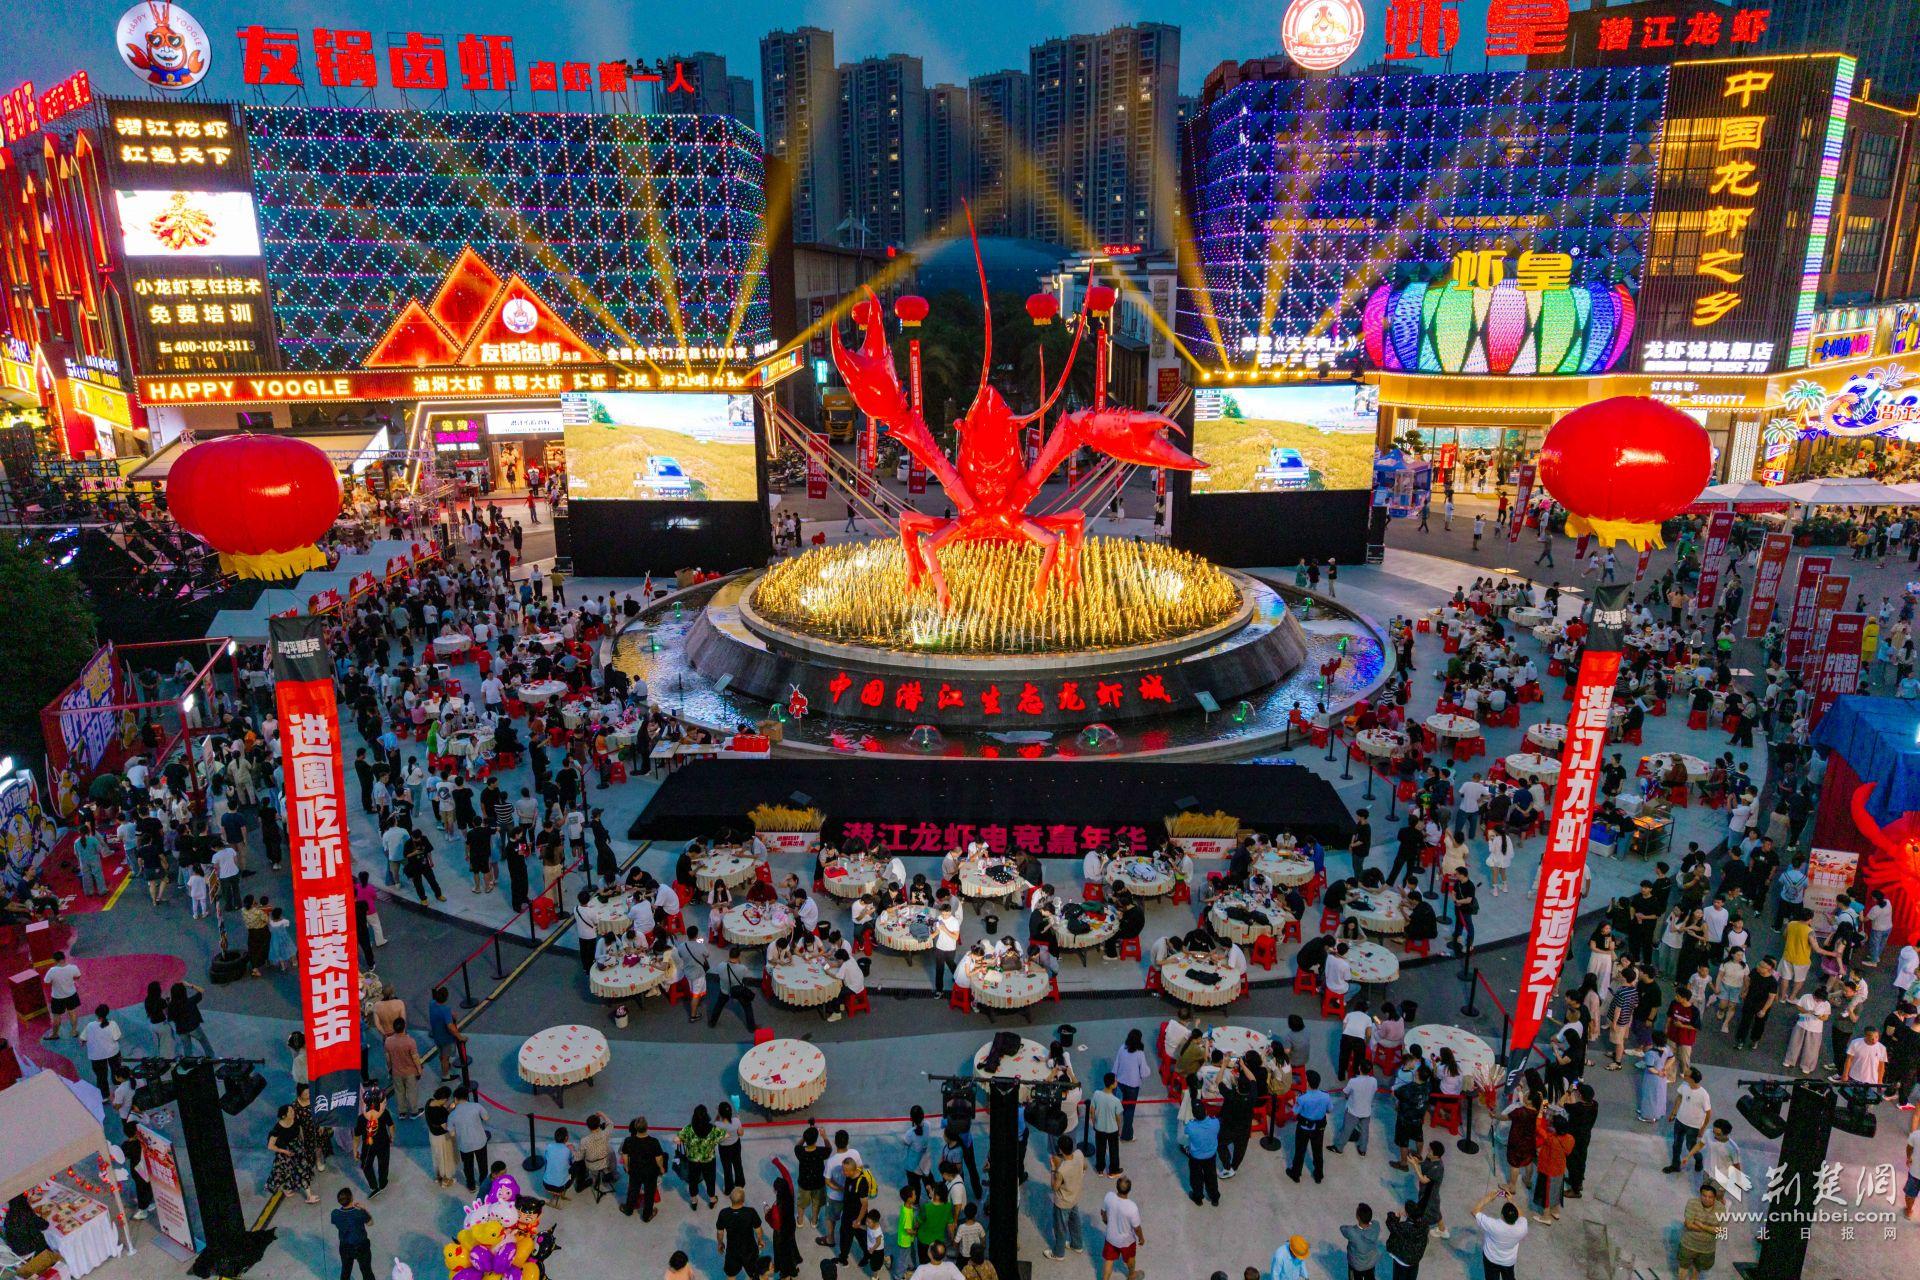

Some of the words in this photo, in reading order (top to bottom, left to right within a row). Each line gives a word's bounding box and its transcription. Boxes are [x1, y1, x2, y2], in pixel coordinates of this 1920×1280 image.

[1598, 9, 1771, 51] 潜江龙虾
[236, 25, 516, 91] 友锅卤虾
[530, 60, 696, 93] 卤虾第一人
[115, 118, 228, 138] 潜江龙虾
[120, 147, 231, 164] 红遍天下
[1692, 70, 1775, 326] 中国龙虾之乡
[135, 279, 262, 295] 小龙虾烹饪技术
[1453, 250, 1572, 291] 虾皇
[150, 303, 252, 324] 免费培训
[150, 381, 234, 400] HAPPY
[251, 379, 351, 397] YOOGLE
[1877, 405, 1920, 421] 潜江
[829, 672, 1172, 715] 中国潜江生态龙虾城
[289, 712, 344, 880] 进圈吃虾
[843, 821, 1148, 855] 潜江龙虾电竞嘉年华
[1527, 868, 1581, 1020] 红遍天下
[304, 893, 351, 1051] 精英出击
